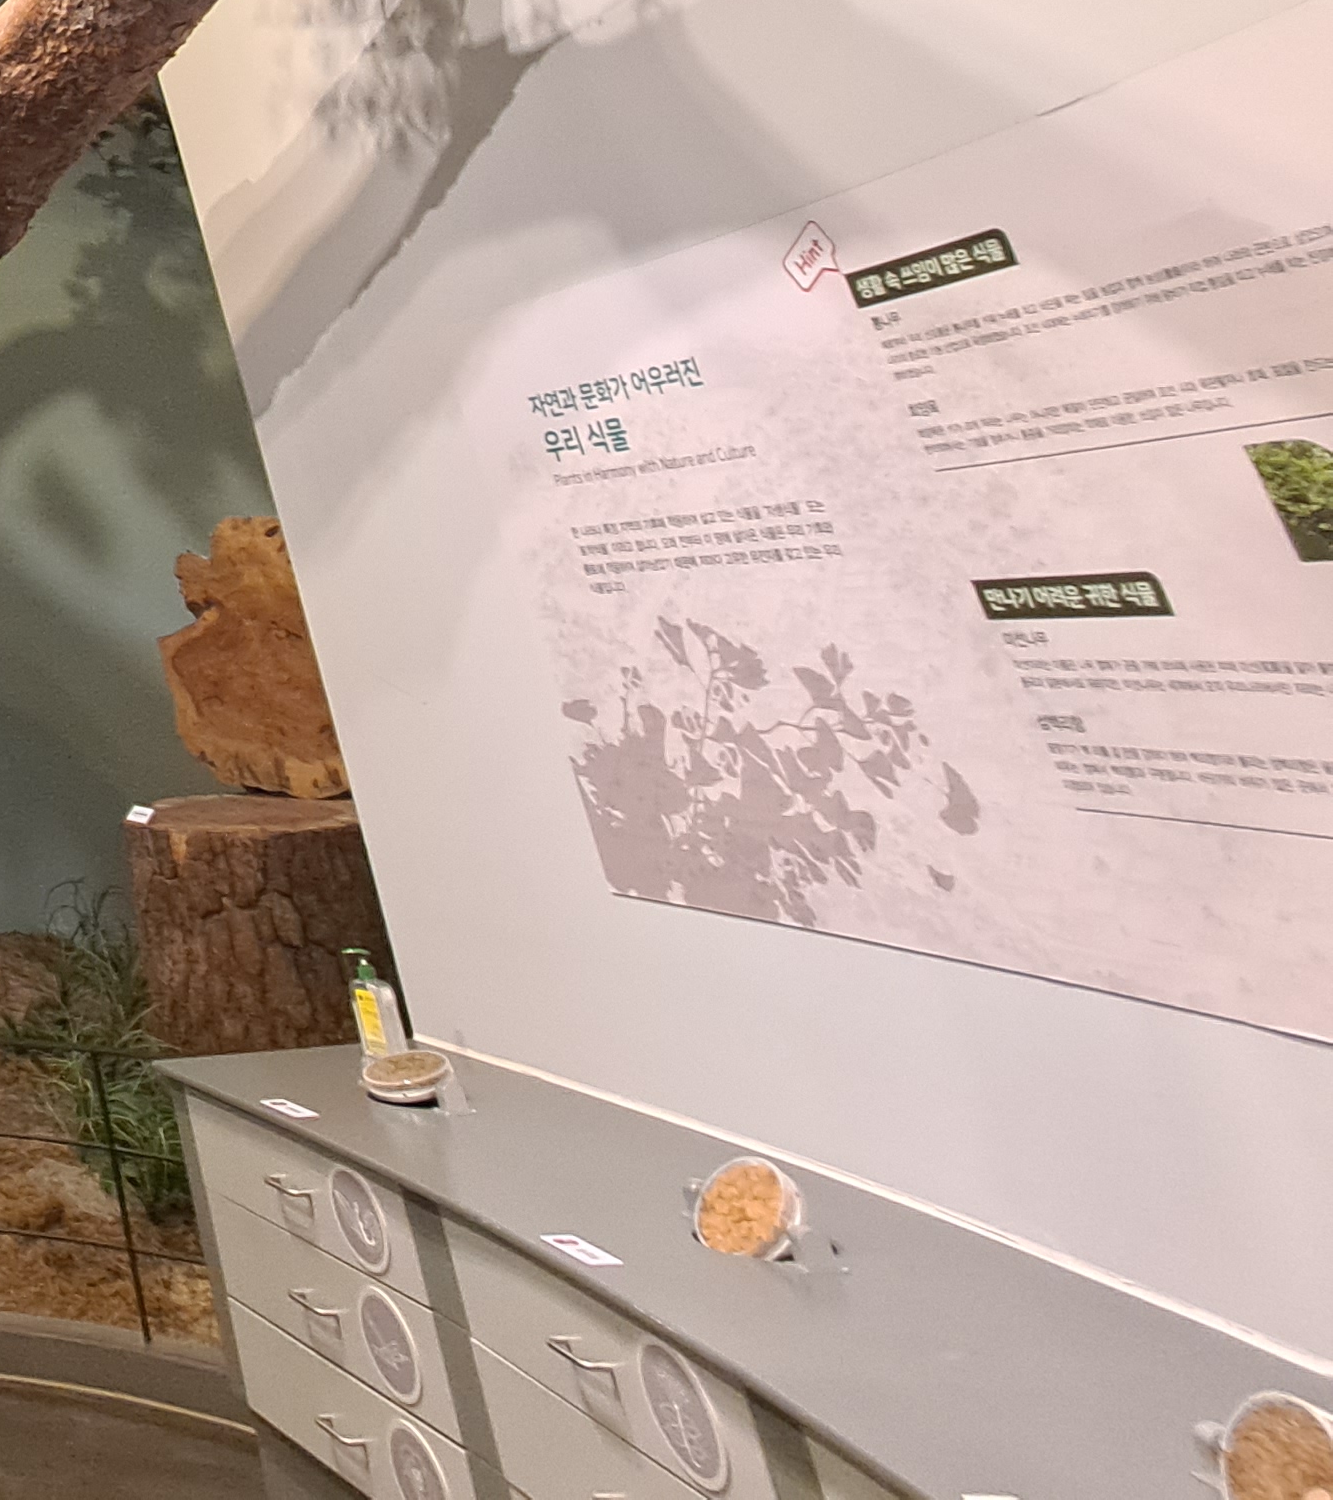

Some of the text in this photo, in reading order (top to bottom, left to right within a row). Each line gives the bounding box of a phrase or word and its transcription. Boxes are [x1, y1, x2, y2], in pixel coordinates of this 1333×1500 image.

[793, 238, 825, 276] Hint
[855, 238, 1007, 299] 생활 속 쓰임이 많은 식물
[528, 356, 704, 418] 자연과 문화가 어우러진
[544, 417, 631, 462] 우리 식물
[593, 464, 638, 481] Harmony
[637, 460, 661, 475] with
[658, 453, 695, 470] Nature
[695, 449, 717, 466] and
[716, 444, 757, 462] Culture
[983, 581, 1161, 612] 만나기 어려운 귀한 식물
